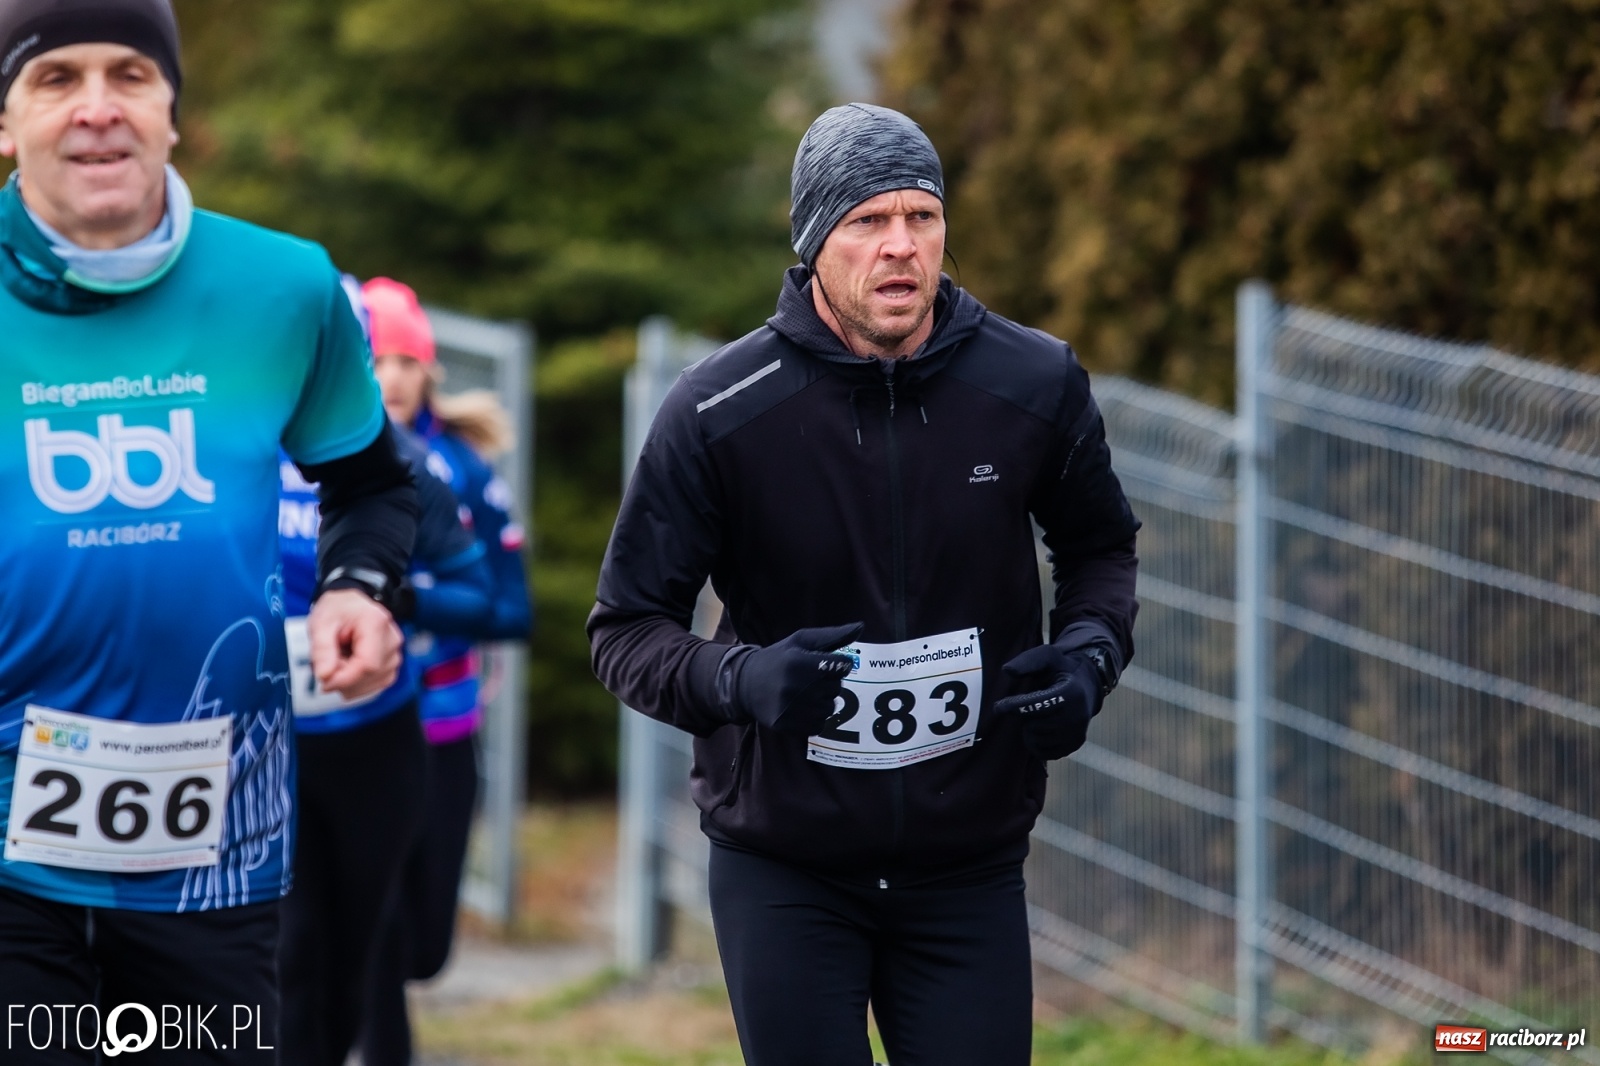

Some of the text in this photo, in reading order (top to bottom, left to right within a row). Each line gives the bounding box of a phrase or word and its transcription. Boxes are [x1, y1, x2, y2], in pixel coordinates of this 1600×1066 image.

[24, 408, 215, 514] bbl
[67, 522, 182, 548] RACIBÓRZ
[869, 644, 974, 669] www.personalbest.pl
[818, 680, 970, 745] 283
[1019, 695, 1065, 713] KIPSTA
[24, 769, 213, 842] 266
